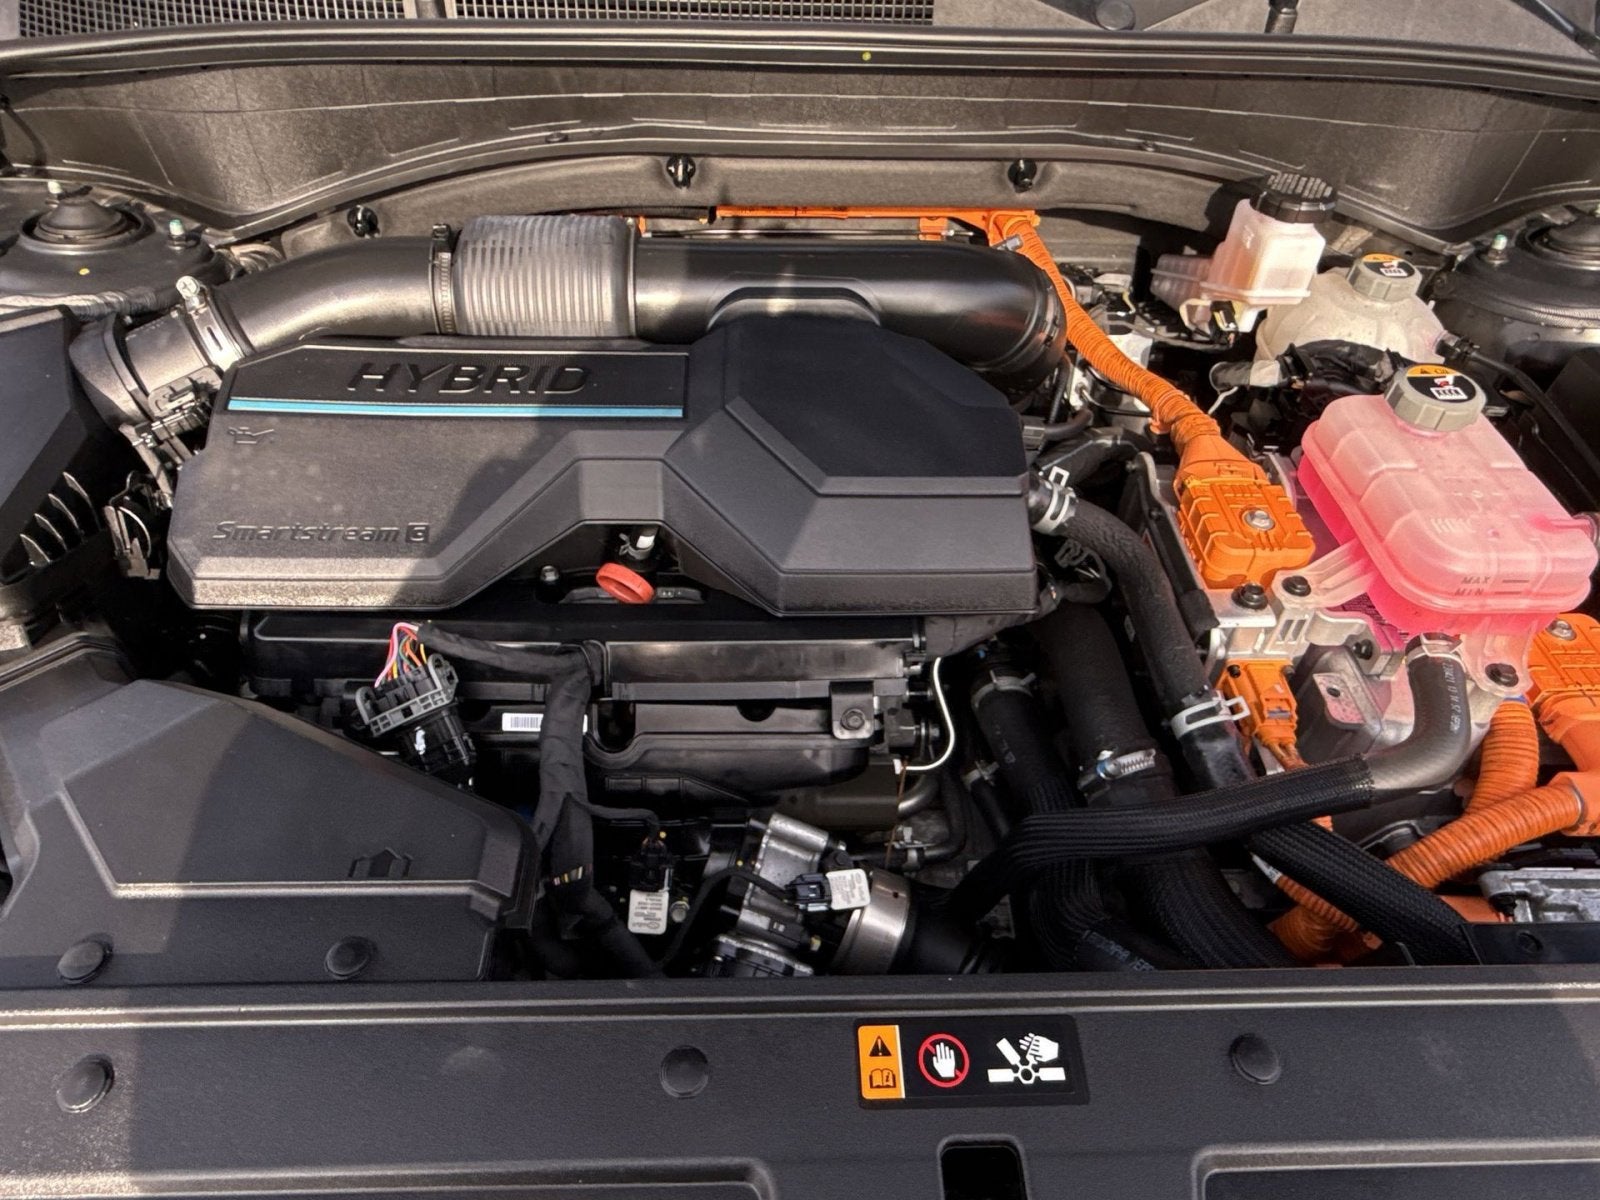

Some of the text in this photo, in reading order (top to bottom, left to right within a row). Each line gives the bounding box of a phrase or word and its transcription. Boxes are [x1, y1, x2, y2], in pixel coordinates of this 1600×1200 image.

[346, 361, 592, 395] HYBRID
[212, 520, 400, 542] Smartstream
[1461, 576, 1491, 585] MAX
[1454, 587, 1485, 596] MIN
